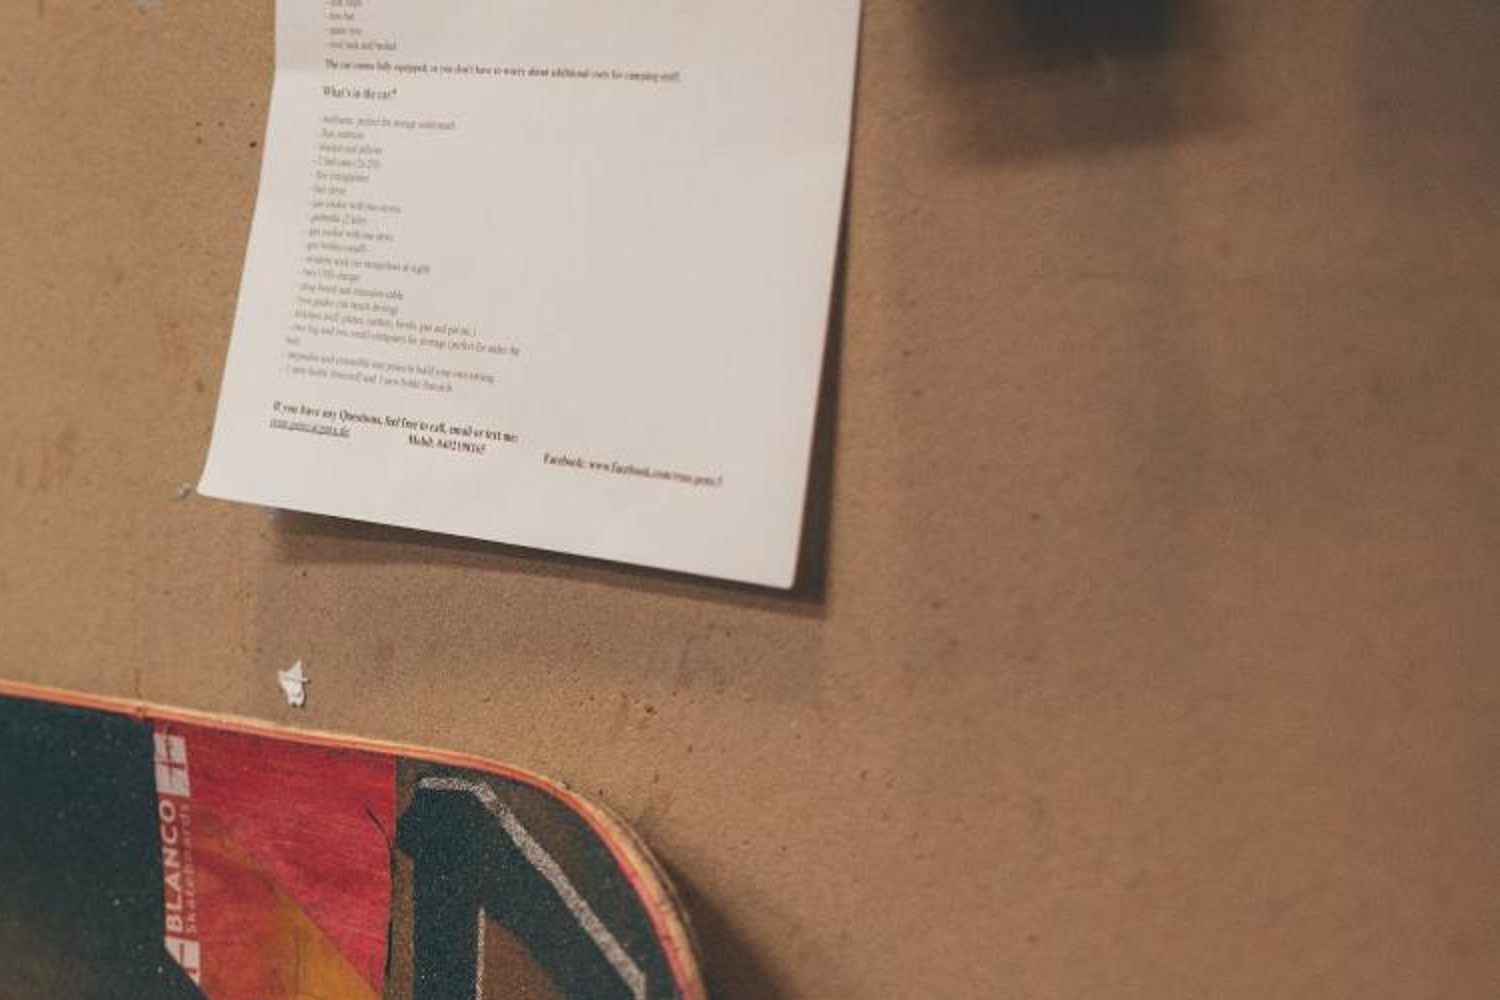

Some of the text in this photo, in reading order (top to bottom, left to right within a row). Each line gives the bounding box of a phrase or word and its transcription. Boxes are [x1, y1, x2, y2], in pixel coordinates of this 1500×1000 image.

[283, 404, 298, 416] you
[300, 403, 319, 417] have
[157, 799, 184, 935] BLANCO
[178, 800, 198, 935] Skateboards
